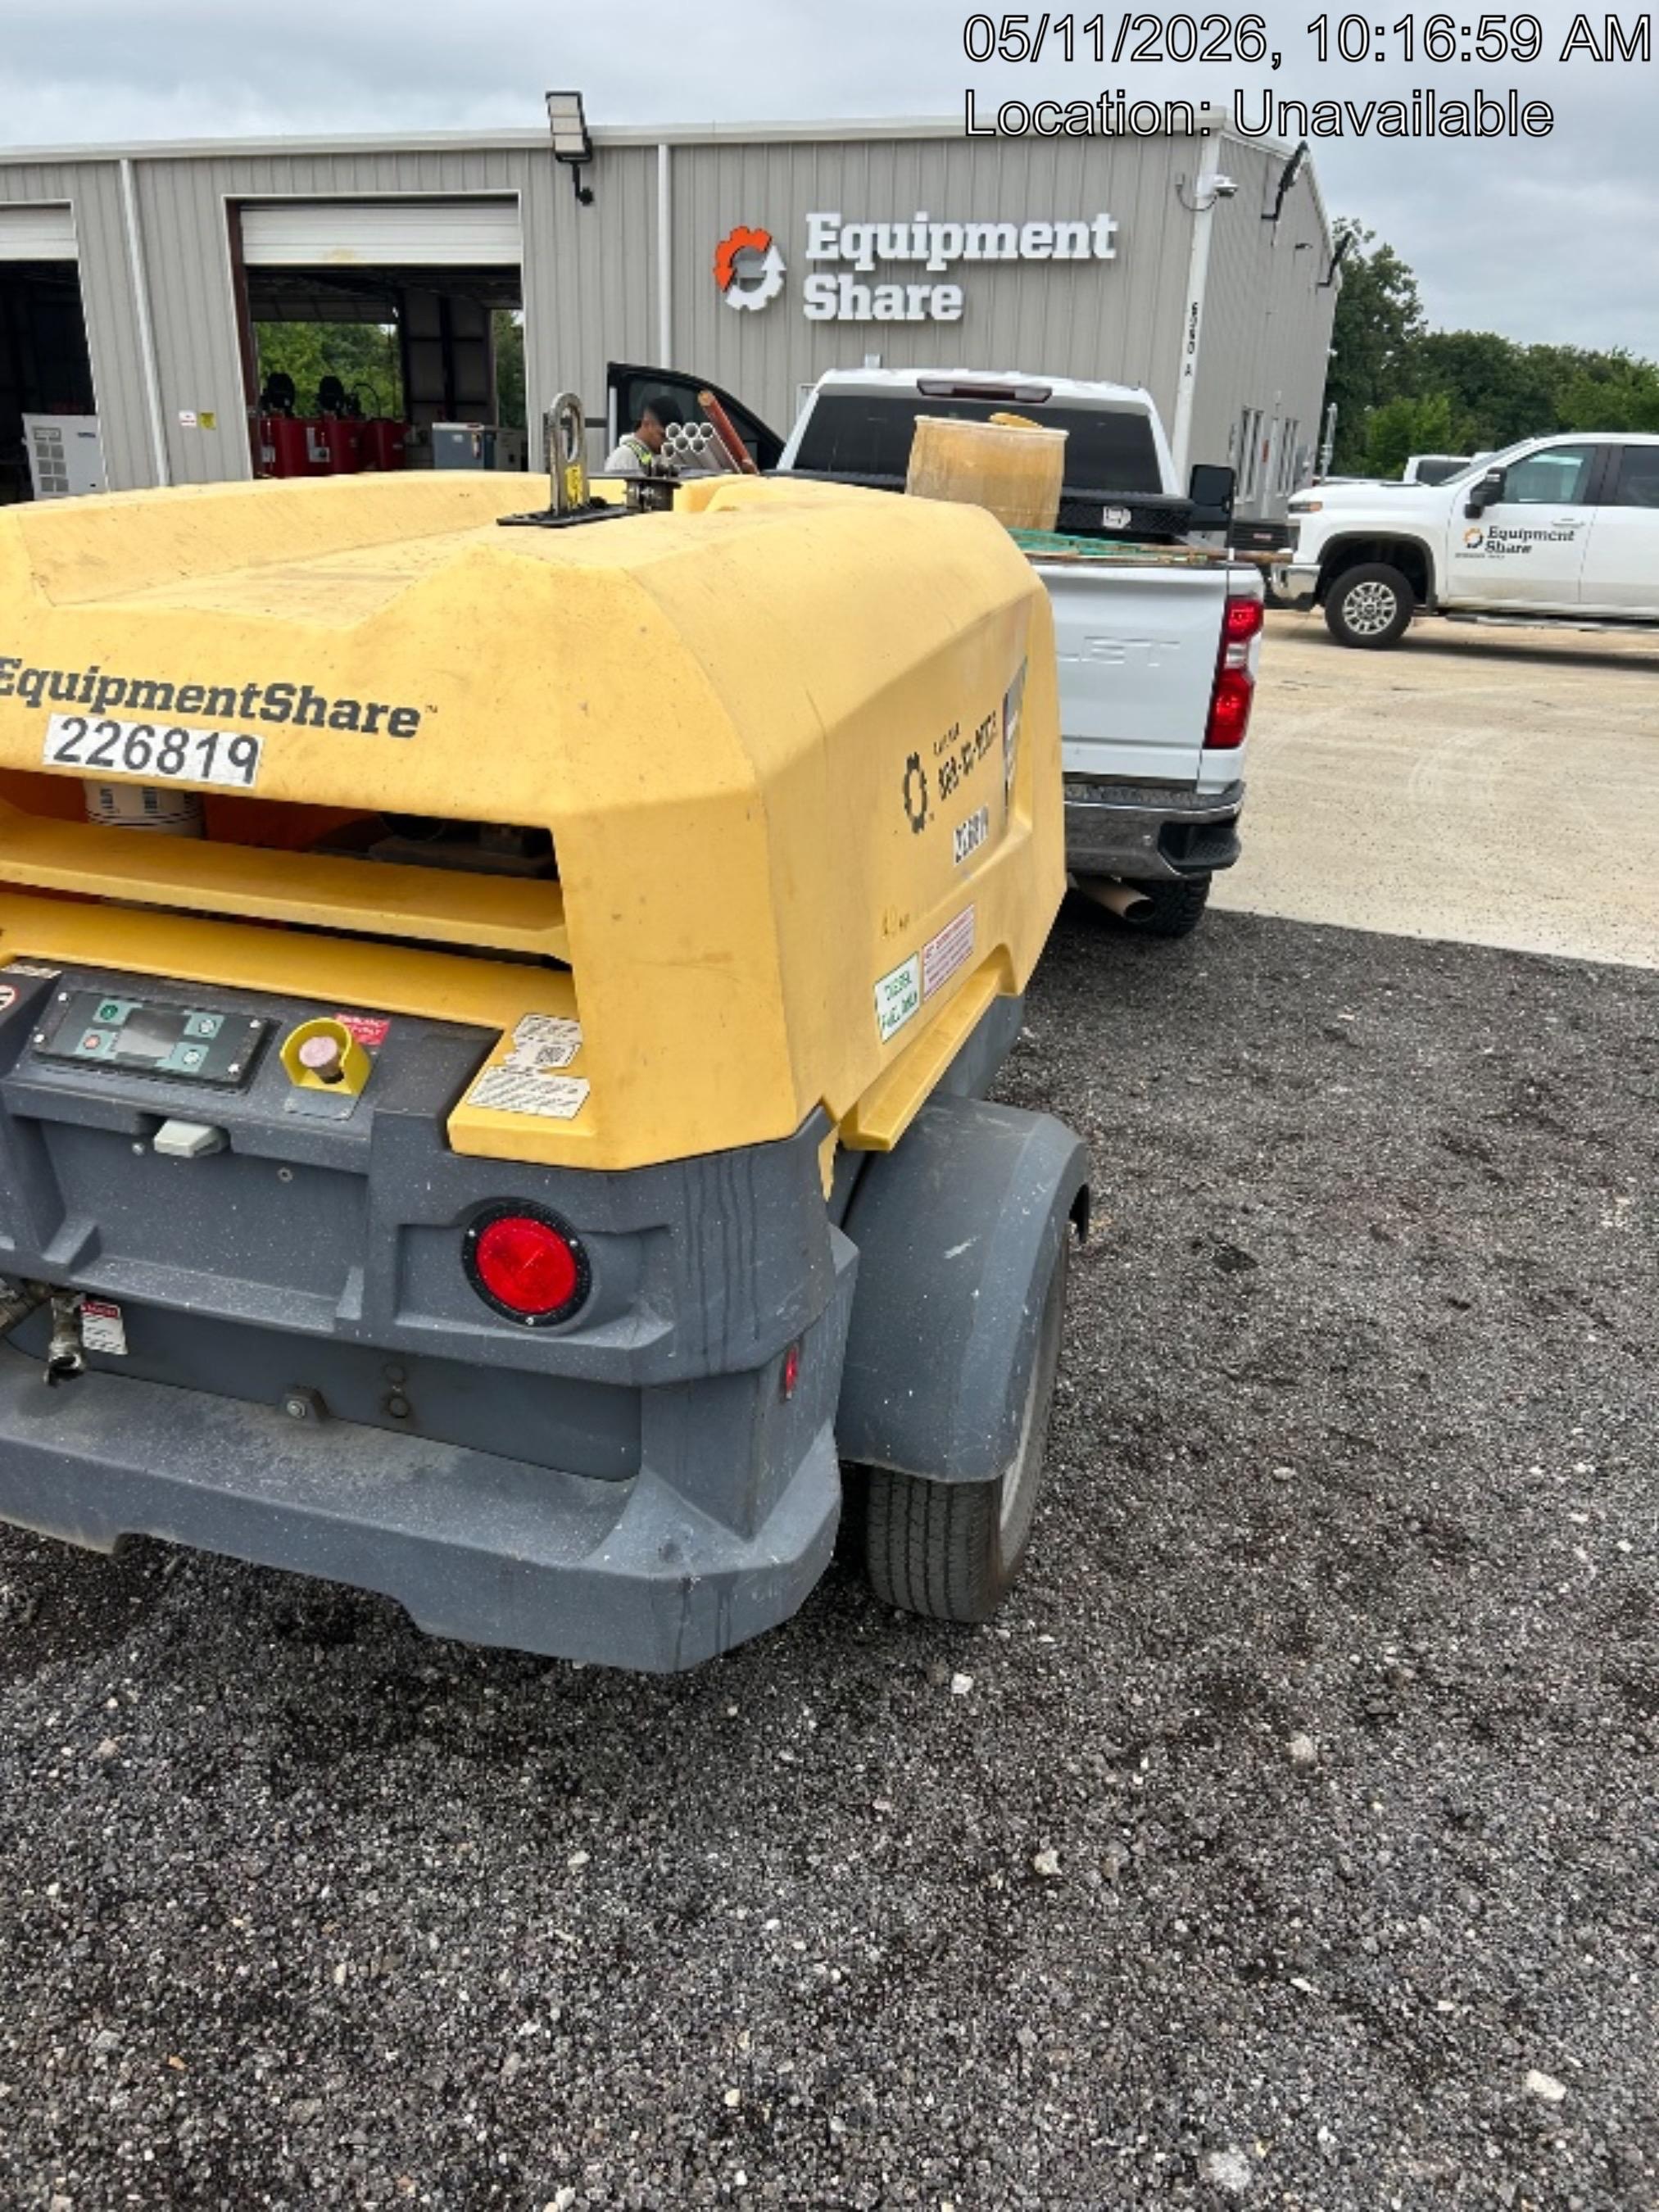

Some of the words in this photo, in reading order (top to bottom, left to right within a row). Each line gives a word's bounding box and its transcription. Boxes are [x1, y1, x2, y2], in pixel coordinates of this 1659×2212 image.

[805, 211, 1119, 271] Equipment
[804, 272, 964, 321] Share
[1484, 540, 1533, 554] Share
[1487, 524, 1575, 543] Equipment
[52, 717, 259, 786] 226819
